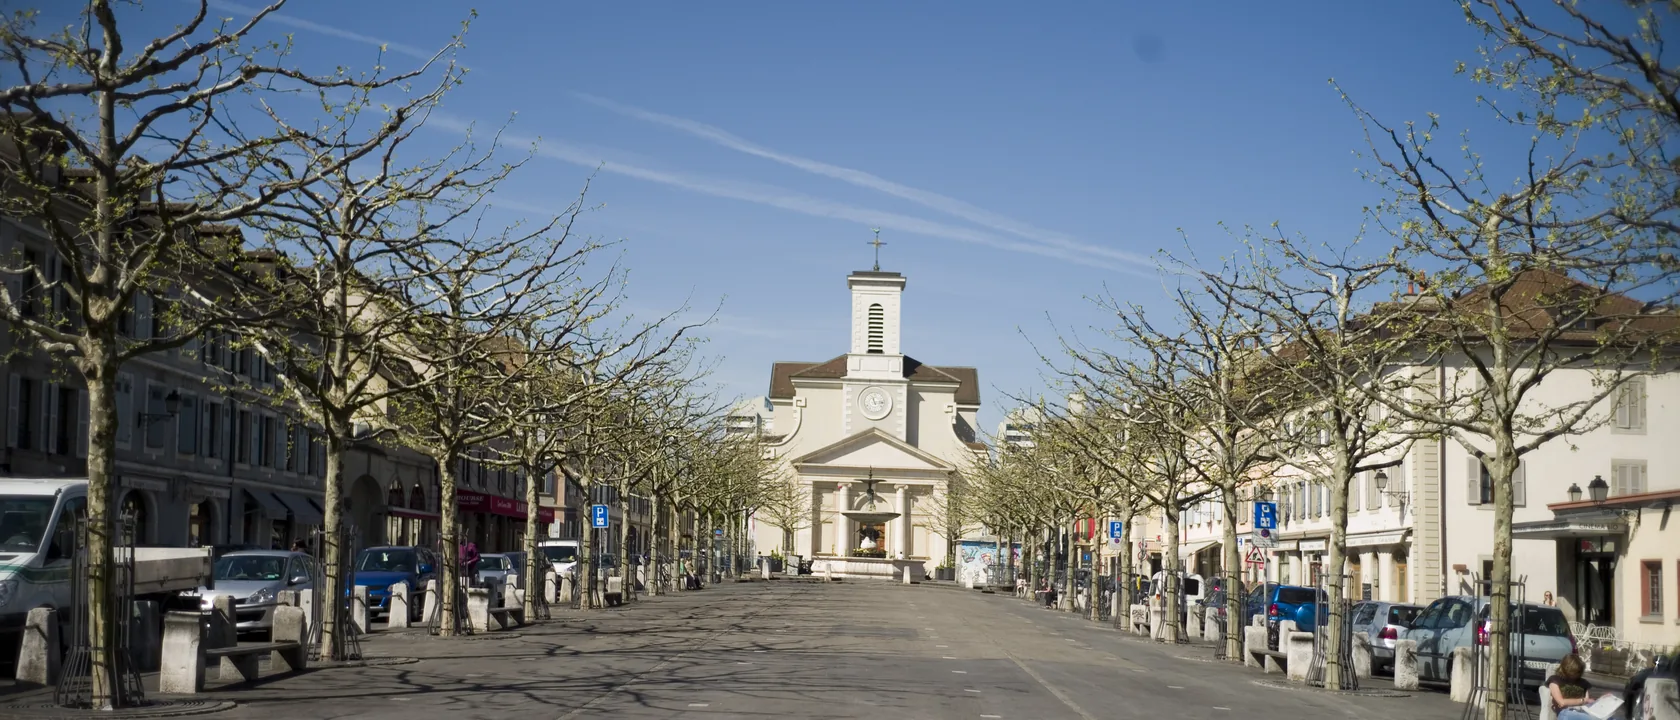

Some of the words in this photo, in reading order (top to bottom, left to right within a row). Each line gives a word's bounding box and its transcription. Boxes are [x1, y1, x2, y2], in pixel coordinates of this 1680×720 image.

[597, 507, 604, 518] P
[1261, 504, 1270, 517] P
[1114, 522, 1120, 531] P
